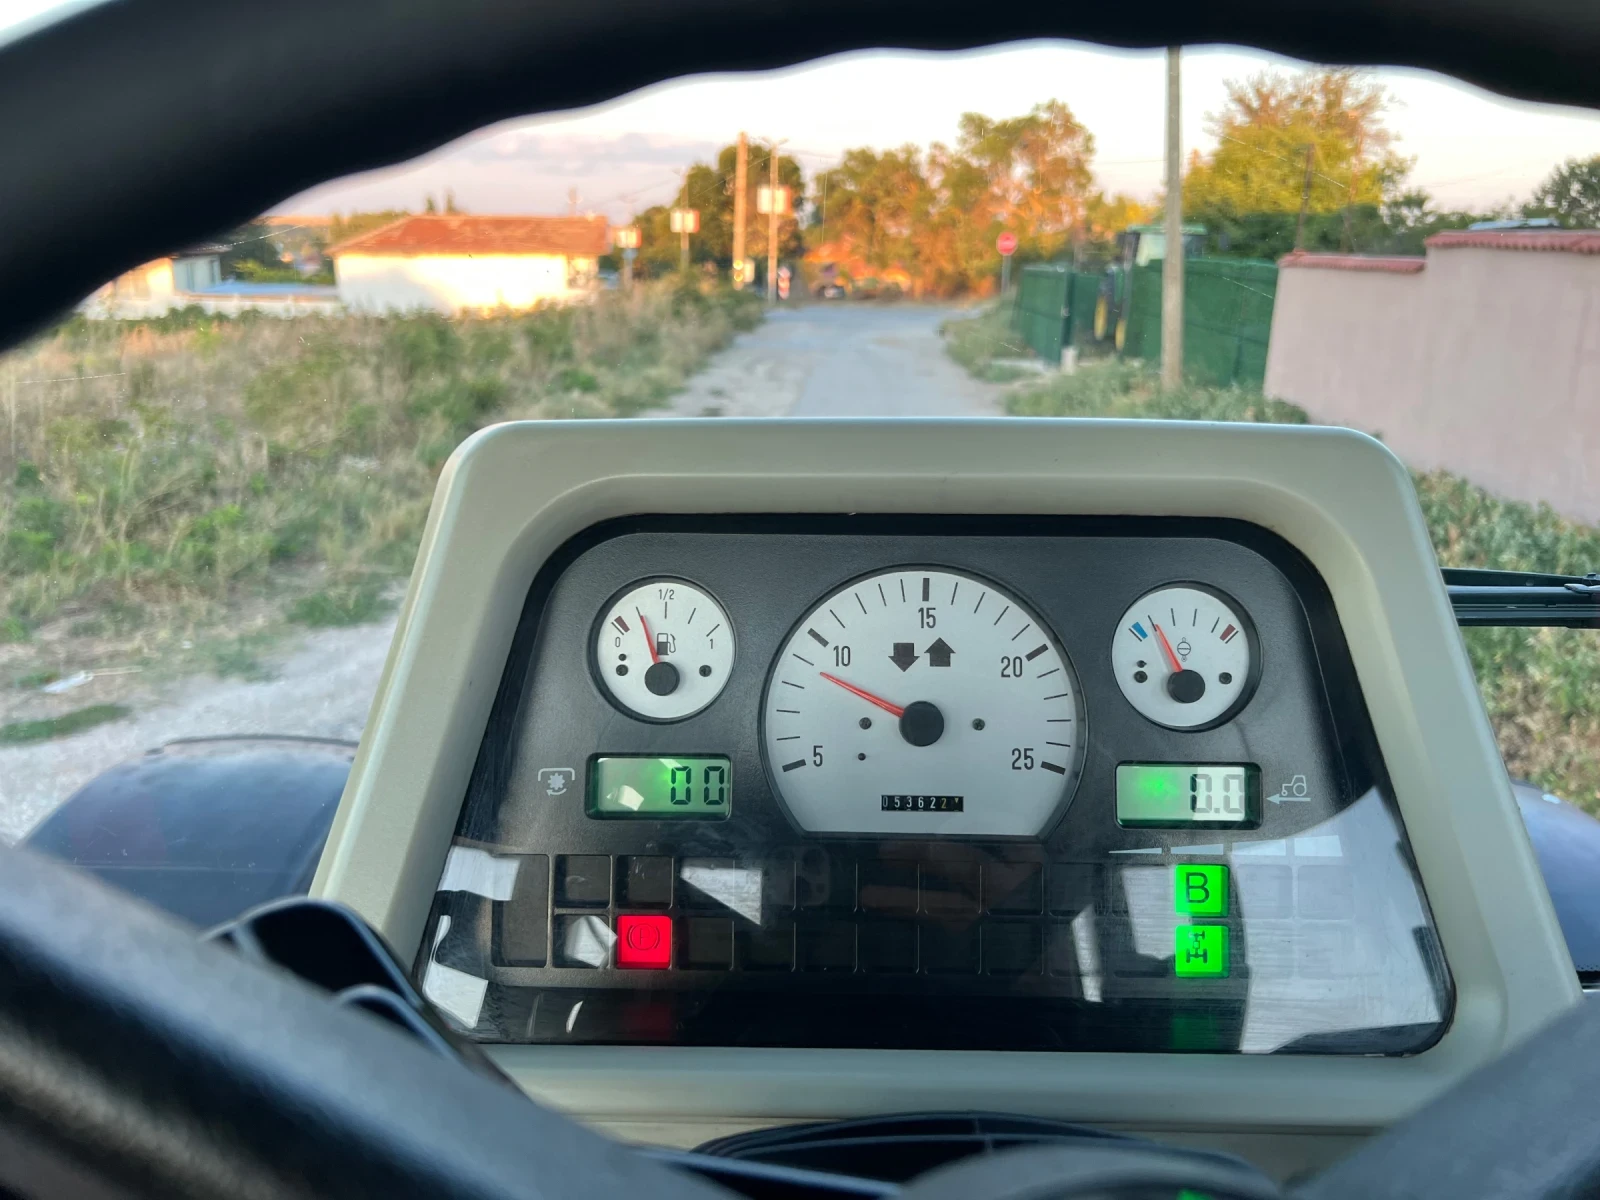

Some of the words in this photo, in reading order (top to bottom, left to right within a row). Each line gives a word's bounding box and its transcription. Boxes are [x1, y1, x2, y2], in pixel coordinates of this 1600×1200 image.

[658, 588, 675, 600] 1/2
[918, 607, 937, 629] 15
[615, 636, 621, 648] 0
[709, 638, 714, 649] 1
[833, 645, 851, 667] 10
[1000, 656, 1023, 678] 20
[812, 745, 824, 767] 5
[1011, 748, 1034, 770] 25
[1190, 773, 1243, 813] 0.0
[1186, 872, 1210, 904] B
